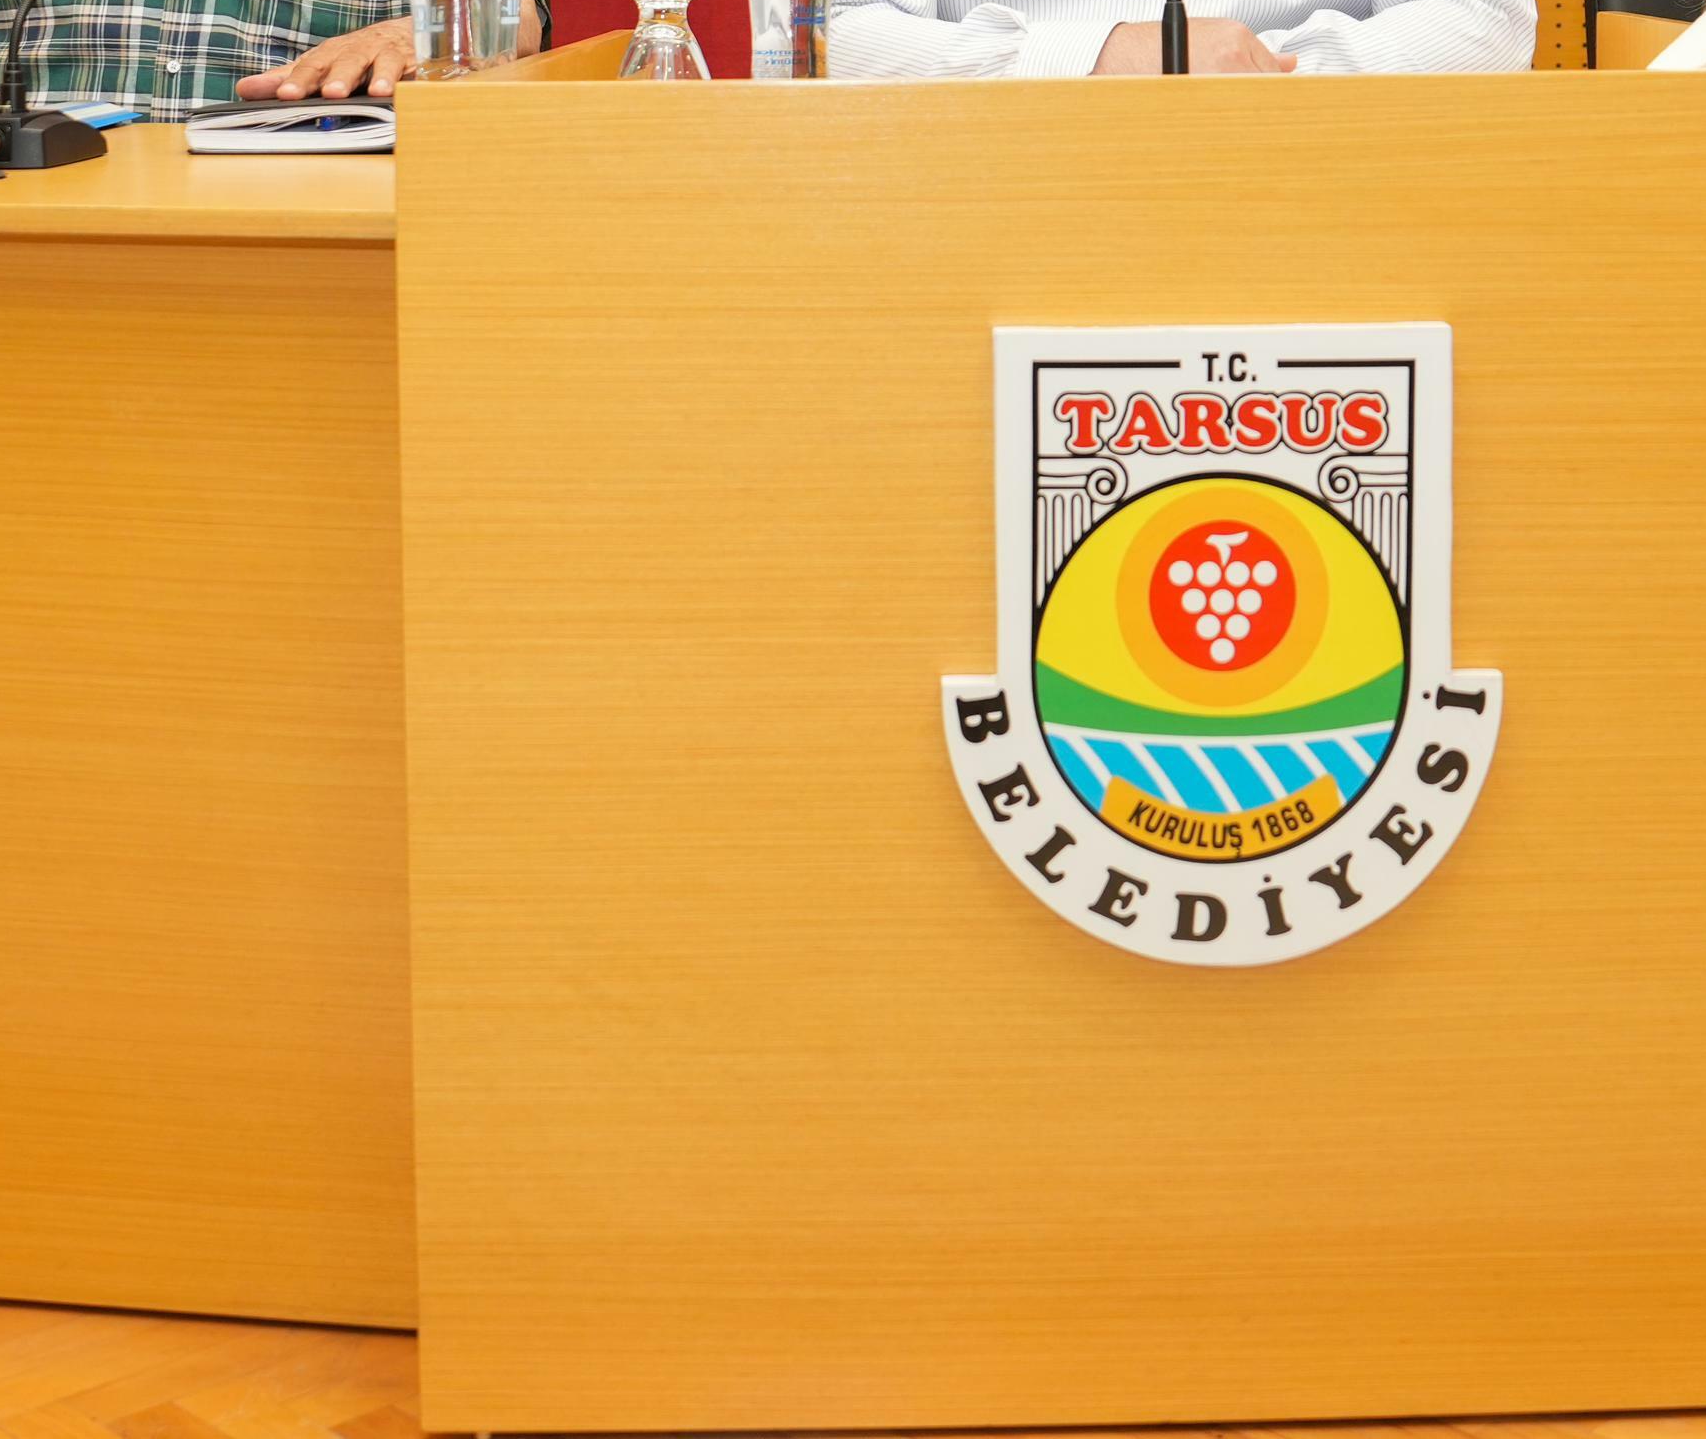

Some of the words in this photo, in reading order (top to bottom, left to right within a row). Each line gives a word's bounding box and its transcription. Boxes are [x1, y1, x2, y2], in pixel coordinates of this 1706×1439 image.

[1200, 353, 1258, 383] T.C.
[1056, 392, 1389, 453] TARSUS
[955, 683, 1486, 943] BELEDİYESİ
[1127, 799, 1244, 858] KURULUŞ
[1251, 798, 1315, 843] 1868
